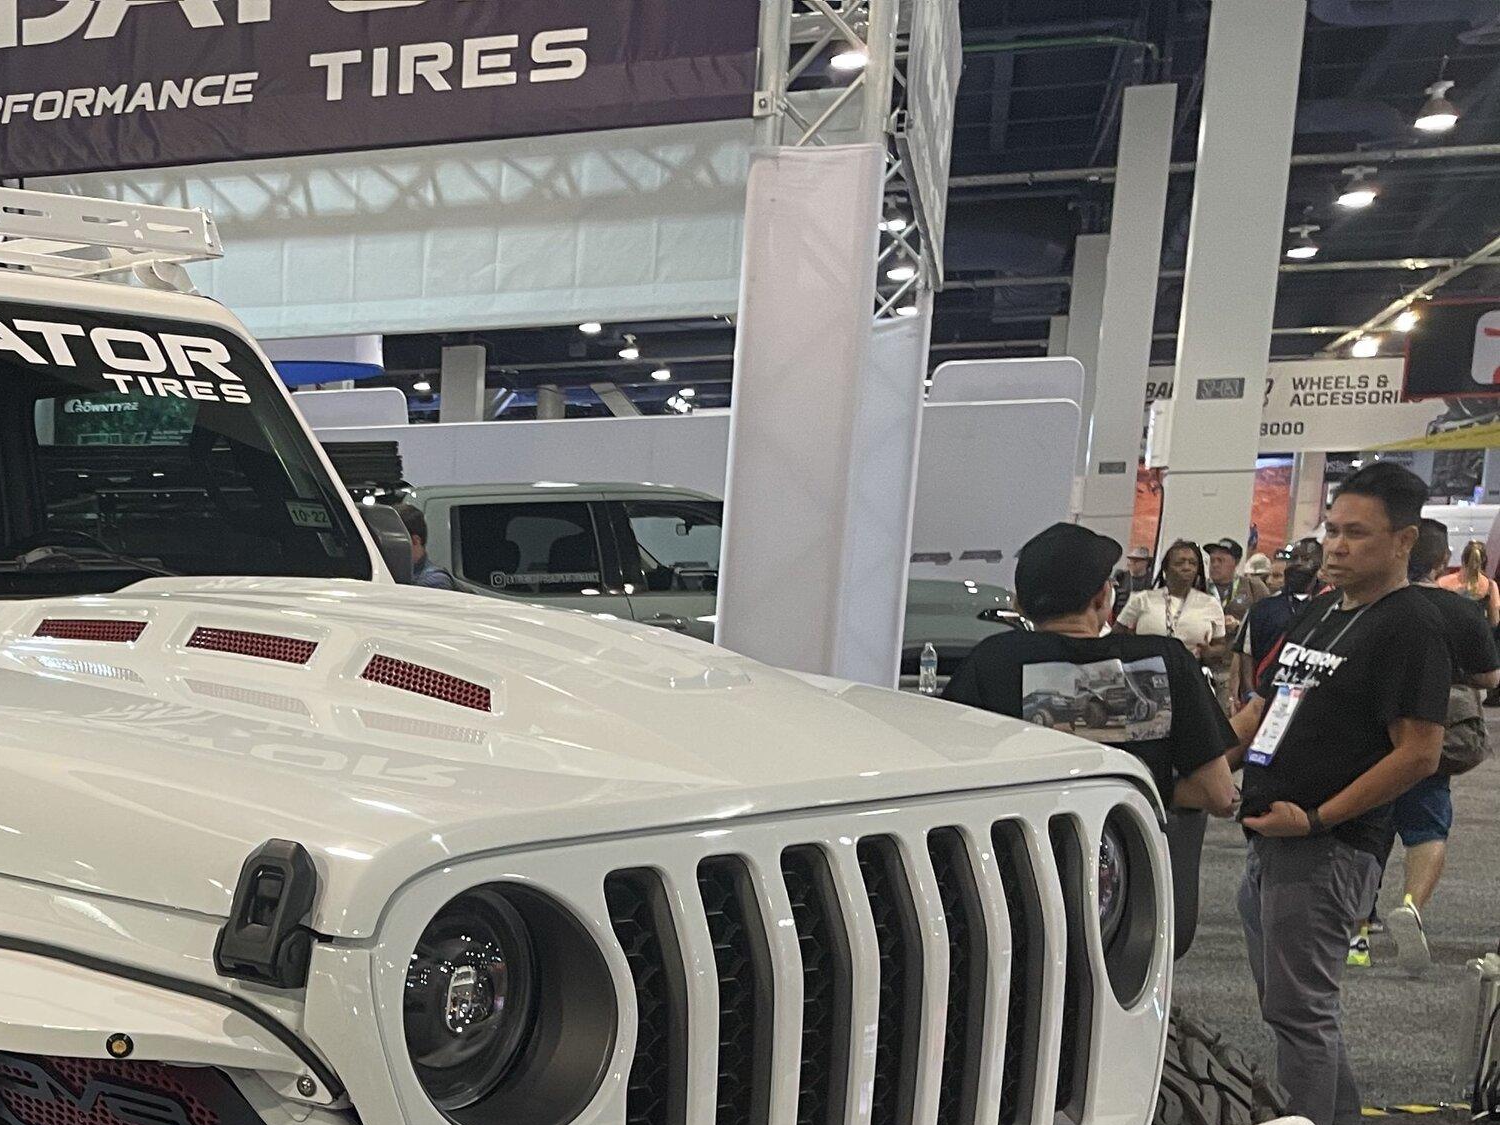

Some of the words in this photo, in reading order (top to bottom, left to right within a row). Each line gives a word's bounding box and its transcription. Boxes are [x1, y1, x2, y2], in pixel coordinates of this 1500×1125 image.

[309, 27, 589, 101] TIRES
[102, 372, 252, 404] TIRES
[1293, 374, 1369, 391] WHEELS
[1376, 374, 1389, 389] &
[1289, 390, 1408, 407] ACCESSORI
